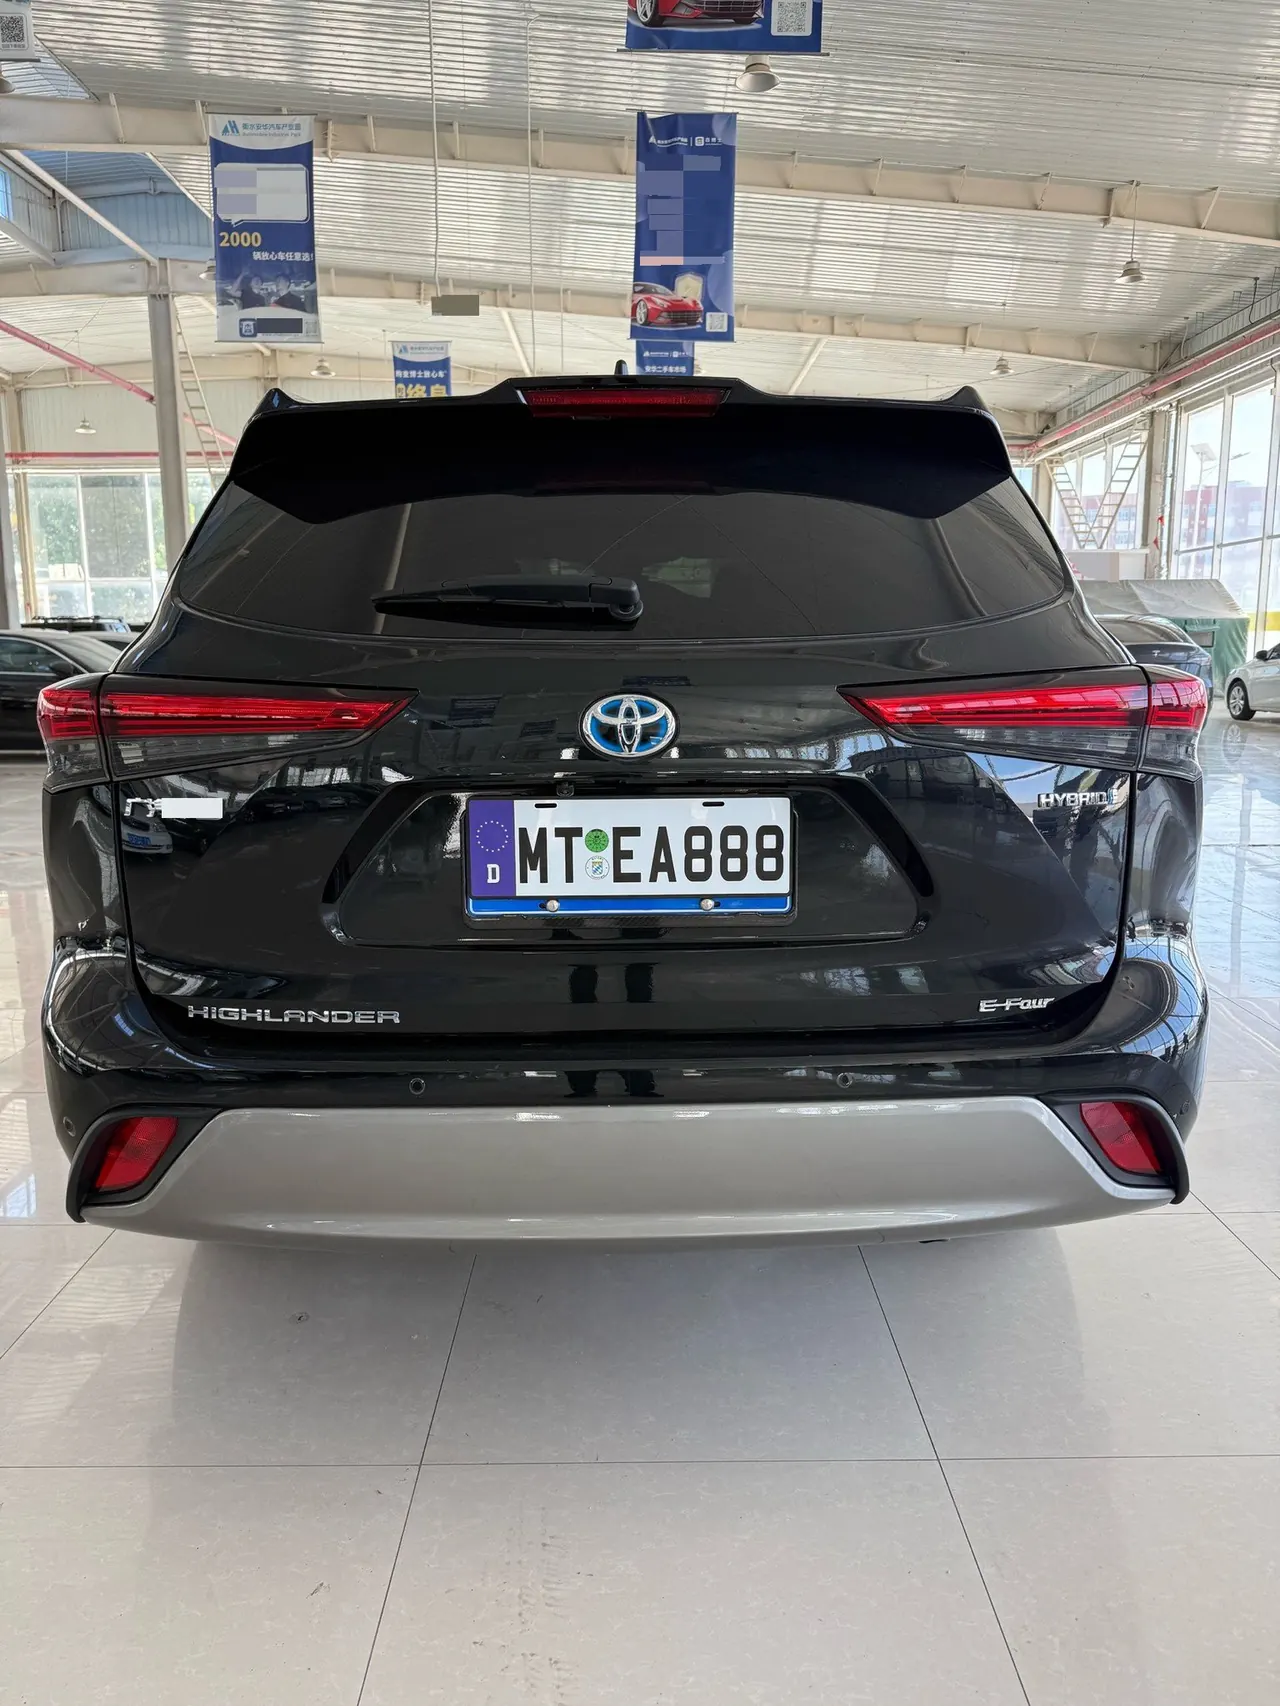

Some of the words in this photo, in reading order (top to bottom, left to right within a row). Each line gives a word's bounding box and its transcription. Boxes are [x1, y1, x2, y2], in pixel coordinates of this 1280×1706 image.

[219, 231, 262, 247] 2000
[1037, 791, 1108, 808] HYBRID
[486, 863, 501, 884] D
[979, 997, 1056, 1013] E-Four
[187, 1005, 401, 1025] HIGHLANDER
